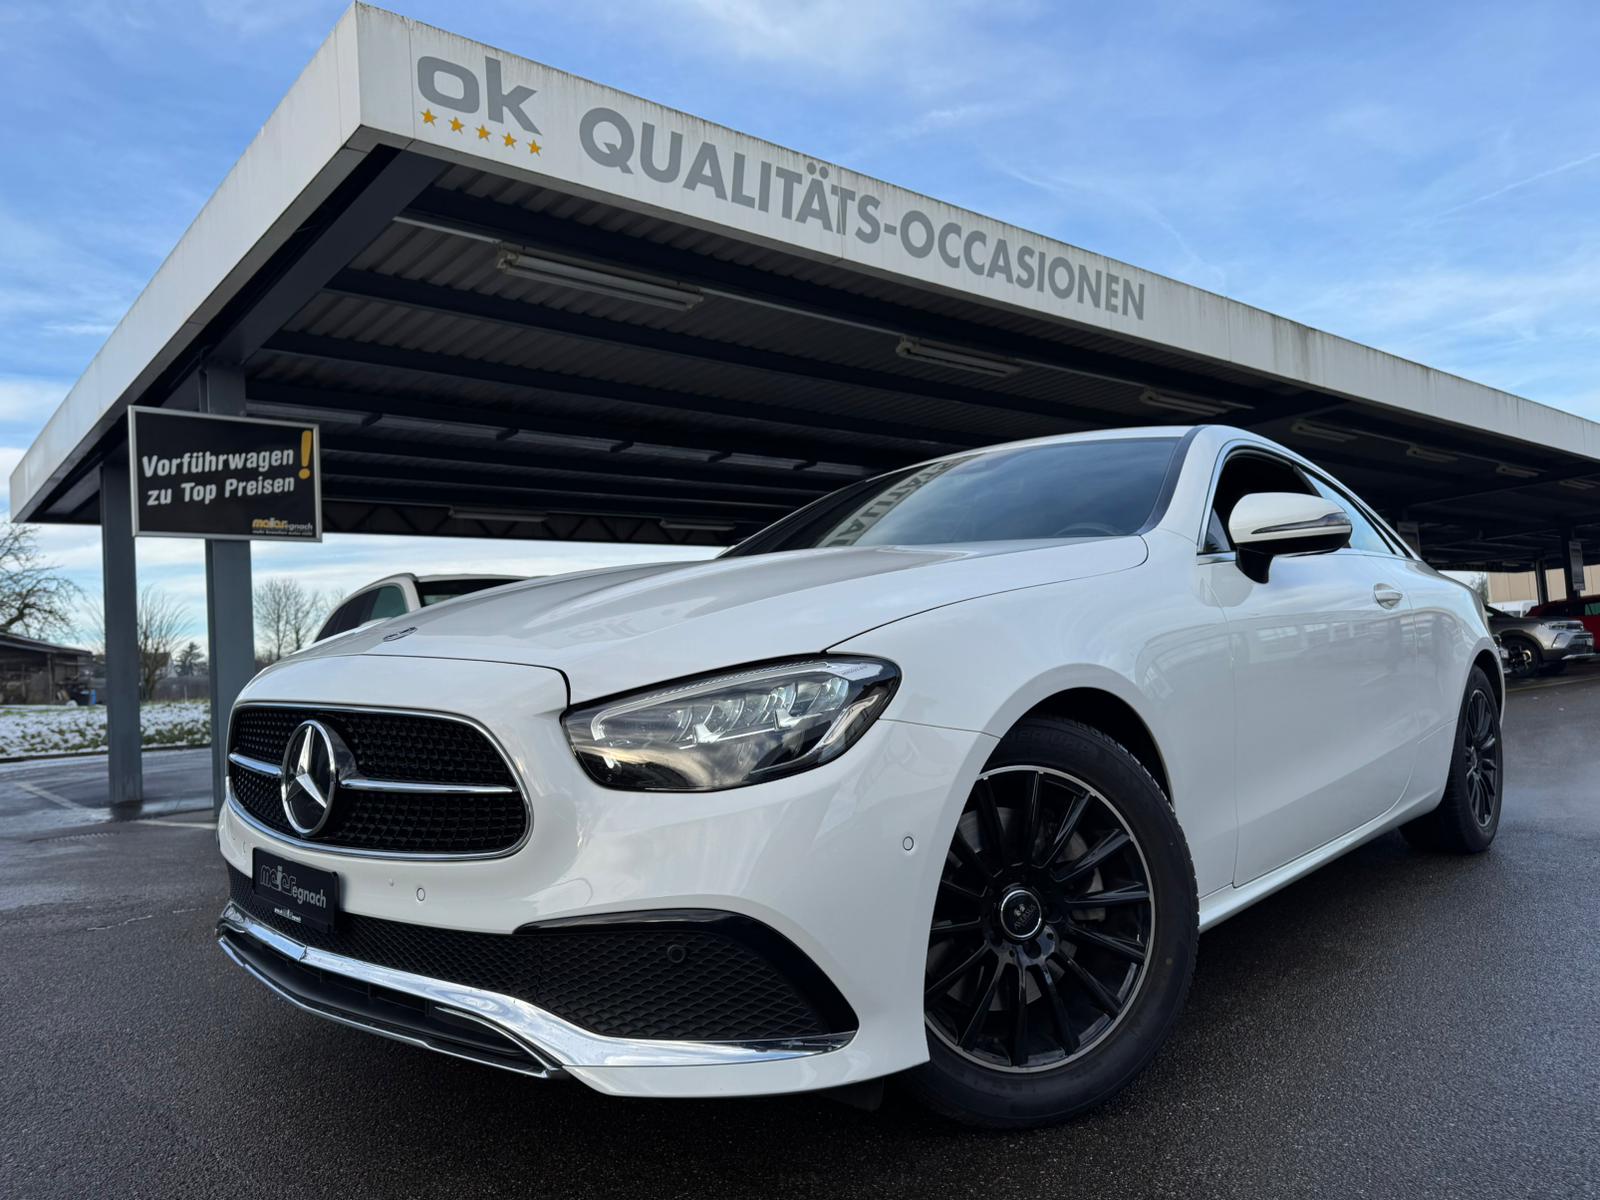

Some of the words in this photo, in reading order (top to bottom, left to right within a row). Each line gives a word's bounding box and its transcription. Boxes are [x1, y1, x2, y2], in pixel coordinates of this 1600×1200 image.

[417, 55, 542, 136] ok
[579, 107, 1144, 320] QUALITÄTS-OCCASIONEN
[142, 449, 294, 478] Vorführwagen
[147, 489, 172, 506] zu
[181, 482, 217, 504] Top
[225, 476, 295, 498] Preisen
